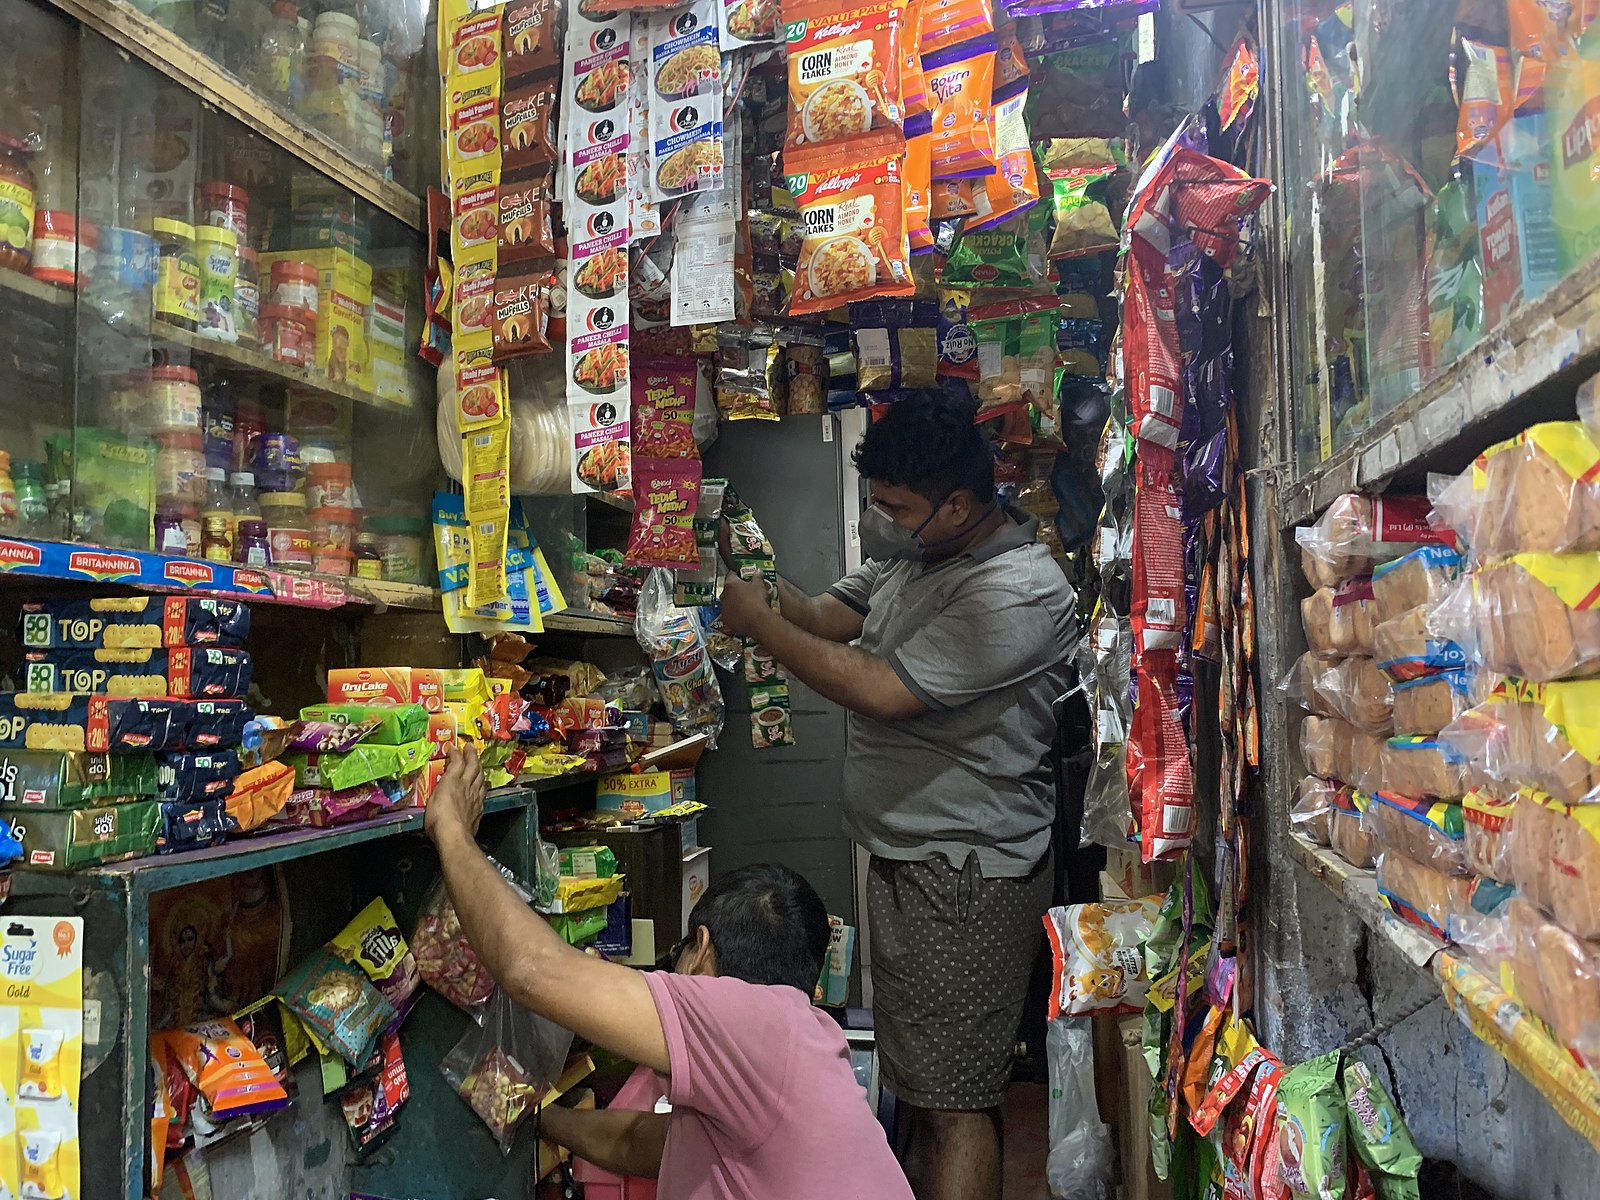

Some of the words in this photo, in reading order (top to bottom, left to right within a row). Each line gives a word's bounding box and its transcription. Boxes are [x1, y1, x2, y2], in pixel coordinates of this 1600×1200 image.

[508, 0, 549, 23] CAKE
[812, 10, 851, 27] VALUE
[852, 1, 896, 19] PACK
[786, 22, 806, 38] 20
[813, 20, 863, 40] Kellogg's
[834, 43, 857, 55] Real
[801, 51, 832, 72] CORN
[834, 52, 858, 63] ALMOND
[834, 60, 853, 70] HONEY
[801, 67, 832, 81] FLAKES
[930, 70, 970, 92] Bourn
[936, 82, 962, 104] Vita
[503, 91, 545, 116] CAKE
[666, 127, 703, 146] CHOWMEIN
[578, 146, 603, 158] PANEER
[603, 138, 623, 150] CHILLI
[589, 149, 613, 160] MASALA
[788, 174, 806, 193] 20
[814, 172, 862, 195] Kellogg's
[499, 187, 540, 210] CAKE
[804, 207, 834, 226] CORN
[837, 208, 860, 219] ALMOND
[837, 216, 856, 227] HONEY
[578, 239, 603, 251] PANEER
[603, 231, 623, 244] CHILLI
[589, 243, 612, 254] MASALA
[209, 255, 231, 269] Sugar
[211, 265, 228, 275] Free
[577, 334, 602, 345] PANEER
[602, 327, 622, 339] CHILLI
[587, 338, 612, 348] MASALA
[963, 339, 974, 347] No
[945, 339, 963, 350] Rulz
[645, 385, 675, 402] TEDHE
[655, 396, 687, 410] MEDHE
[663, 411, 678, 420] 50
[580, 429, 605, 441] PANEER
[604, 424, 624, 436] CHILLI
[591, 434, 614, 445] MASALA
[648, 490, 678, 505] TEDHE
[656, 500, 688, 514] MEDHE
[438, 510, 458, 522] Buy
[664, 515, 678, 525] 50
[0, 547, 34, 560] ANNIA
[505, 552, 526, 566] ACK
[169, 565, 208, 578] BRITANNIA
[445, 568, 469, 583] VA
[25, 615, 49, 631] 50
[58, 619, 103, 641] TOP
[25, 631, 48, 643] 50
[30, 665, 52, 681] 50
[29, 681, 51, 693] 50
[61, 669, 106, 692] TOP
[0, 715, 25, 740] OP
[159, 765, 175, 786] 00g
[603, 778, 627, 791] 50%
[629, 779, 657, 789] EXTRA
[94, 812, 113, 825] Spin
[94, 822, 114, 833] TOP
[2, 944, 37, 964] Sugar
[8, 962, 32, 976] Free
[7, 984, 31, 998] Gold
